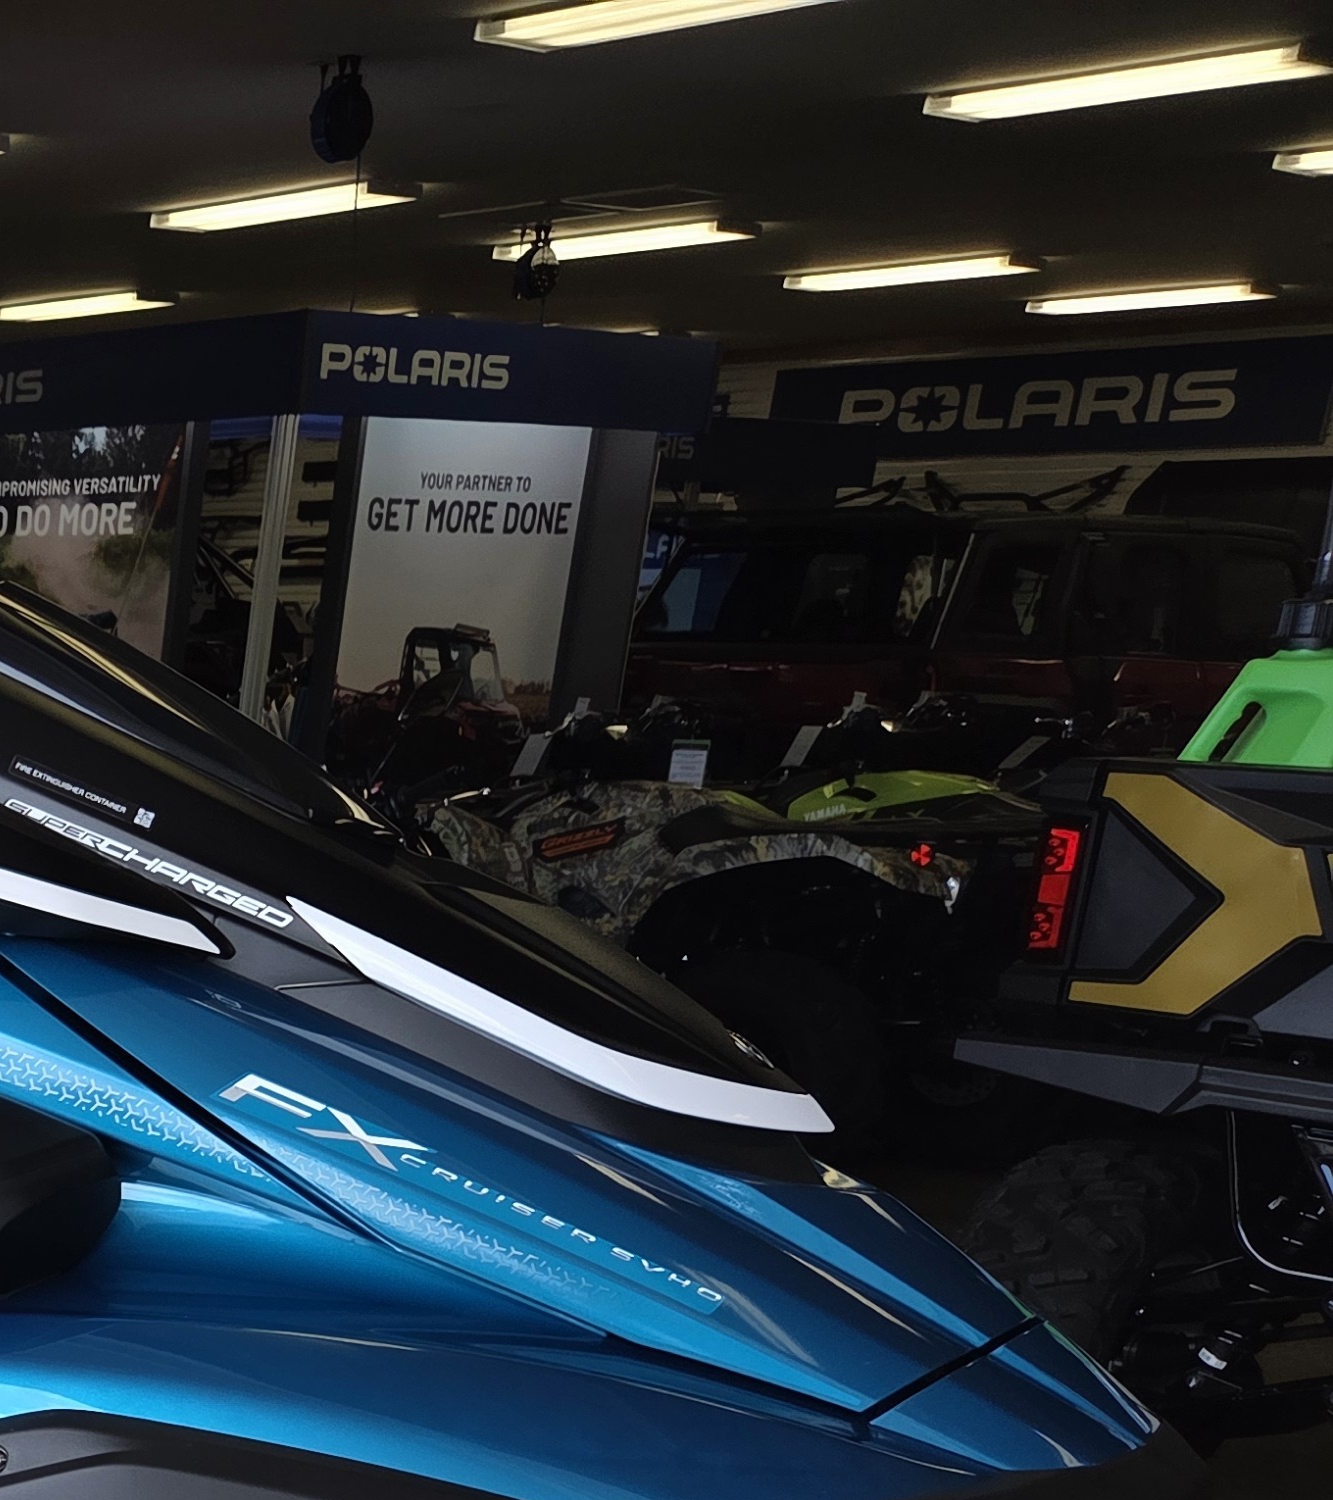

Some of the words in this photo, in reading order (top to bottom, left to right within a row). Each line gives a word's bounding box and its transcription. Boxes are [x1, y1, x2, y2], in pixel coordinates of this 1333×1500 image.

[320, 342, 510, 391] POLARIS
[838, 368, 1238, 433] POLARIS
[73, 473, 161, 495] VERSATILITY
[420, 471, 453, 490] YOUR
[455, 474, 513, 492] PARTNER
[516, 476, 531, 492] TO
[15, 503, 51, 537] DO
[58, 501, 137, 537] MORE
[367, 497, 420, 532] GET
[425, 499, 498, 534] MORE
[502, 501, 572, 535] DONE
[14, 761, 33, 775] FIRE
[32, 769, 85, 797] EXTINGUISHER
[84, 791, 127, 814] CONTAINER
[803, 803, 847, 822] YAMAHA
[4, 799, 294, 929] SUPERCHARGED
[218, 1073, 429, 1172] FX
[399, 1153, 599, 1244] CRUISER
[609, 1246, 723, 1302] SVHO
